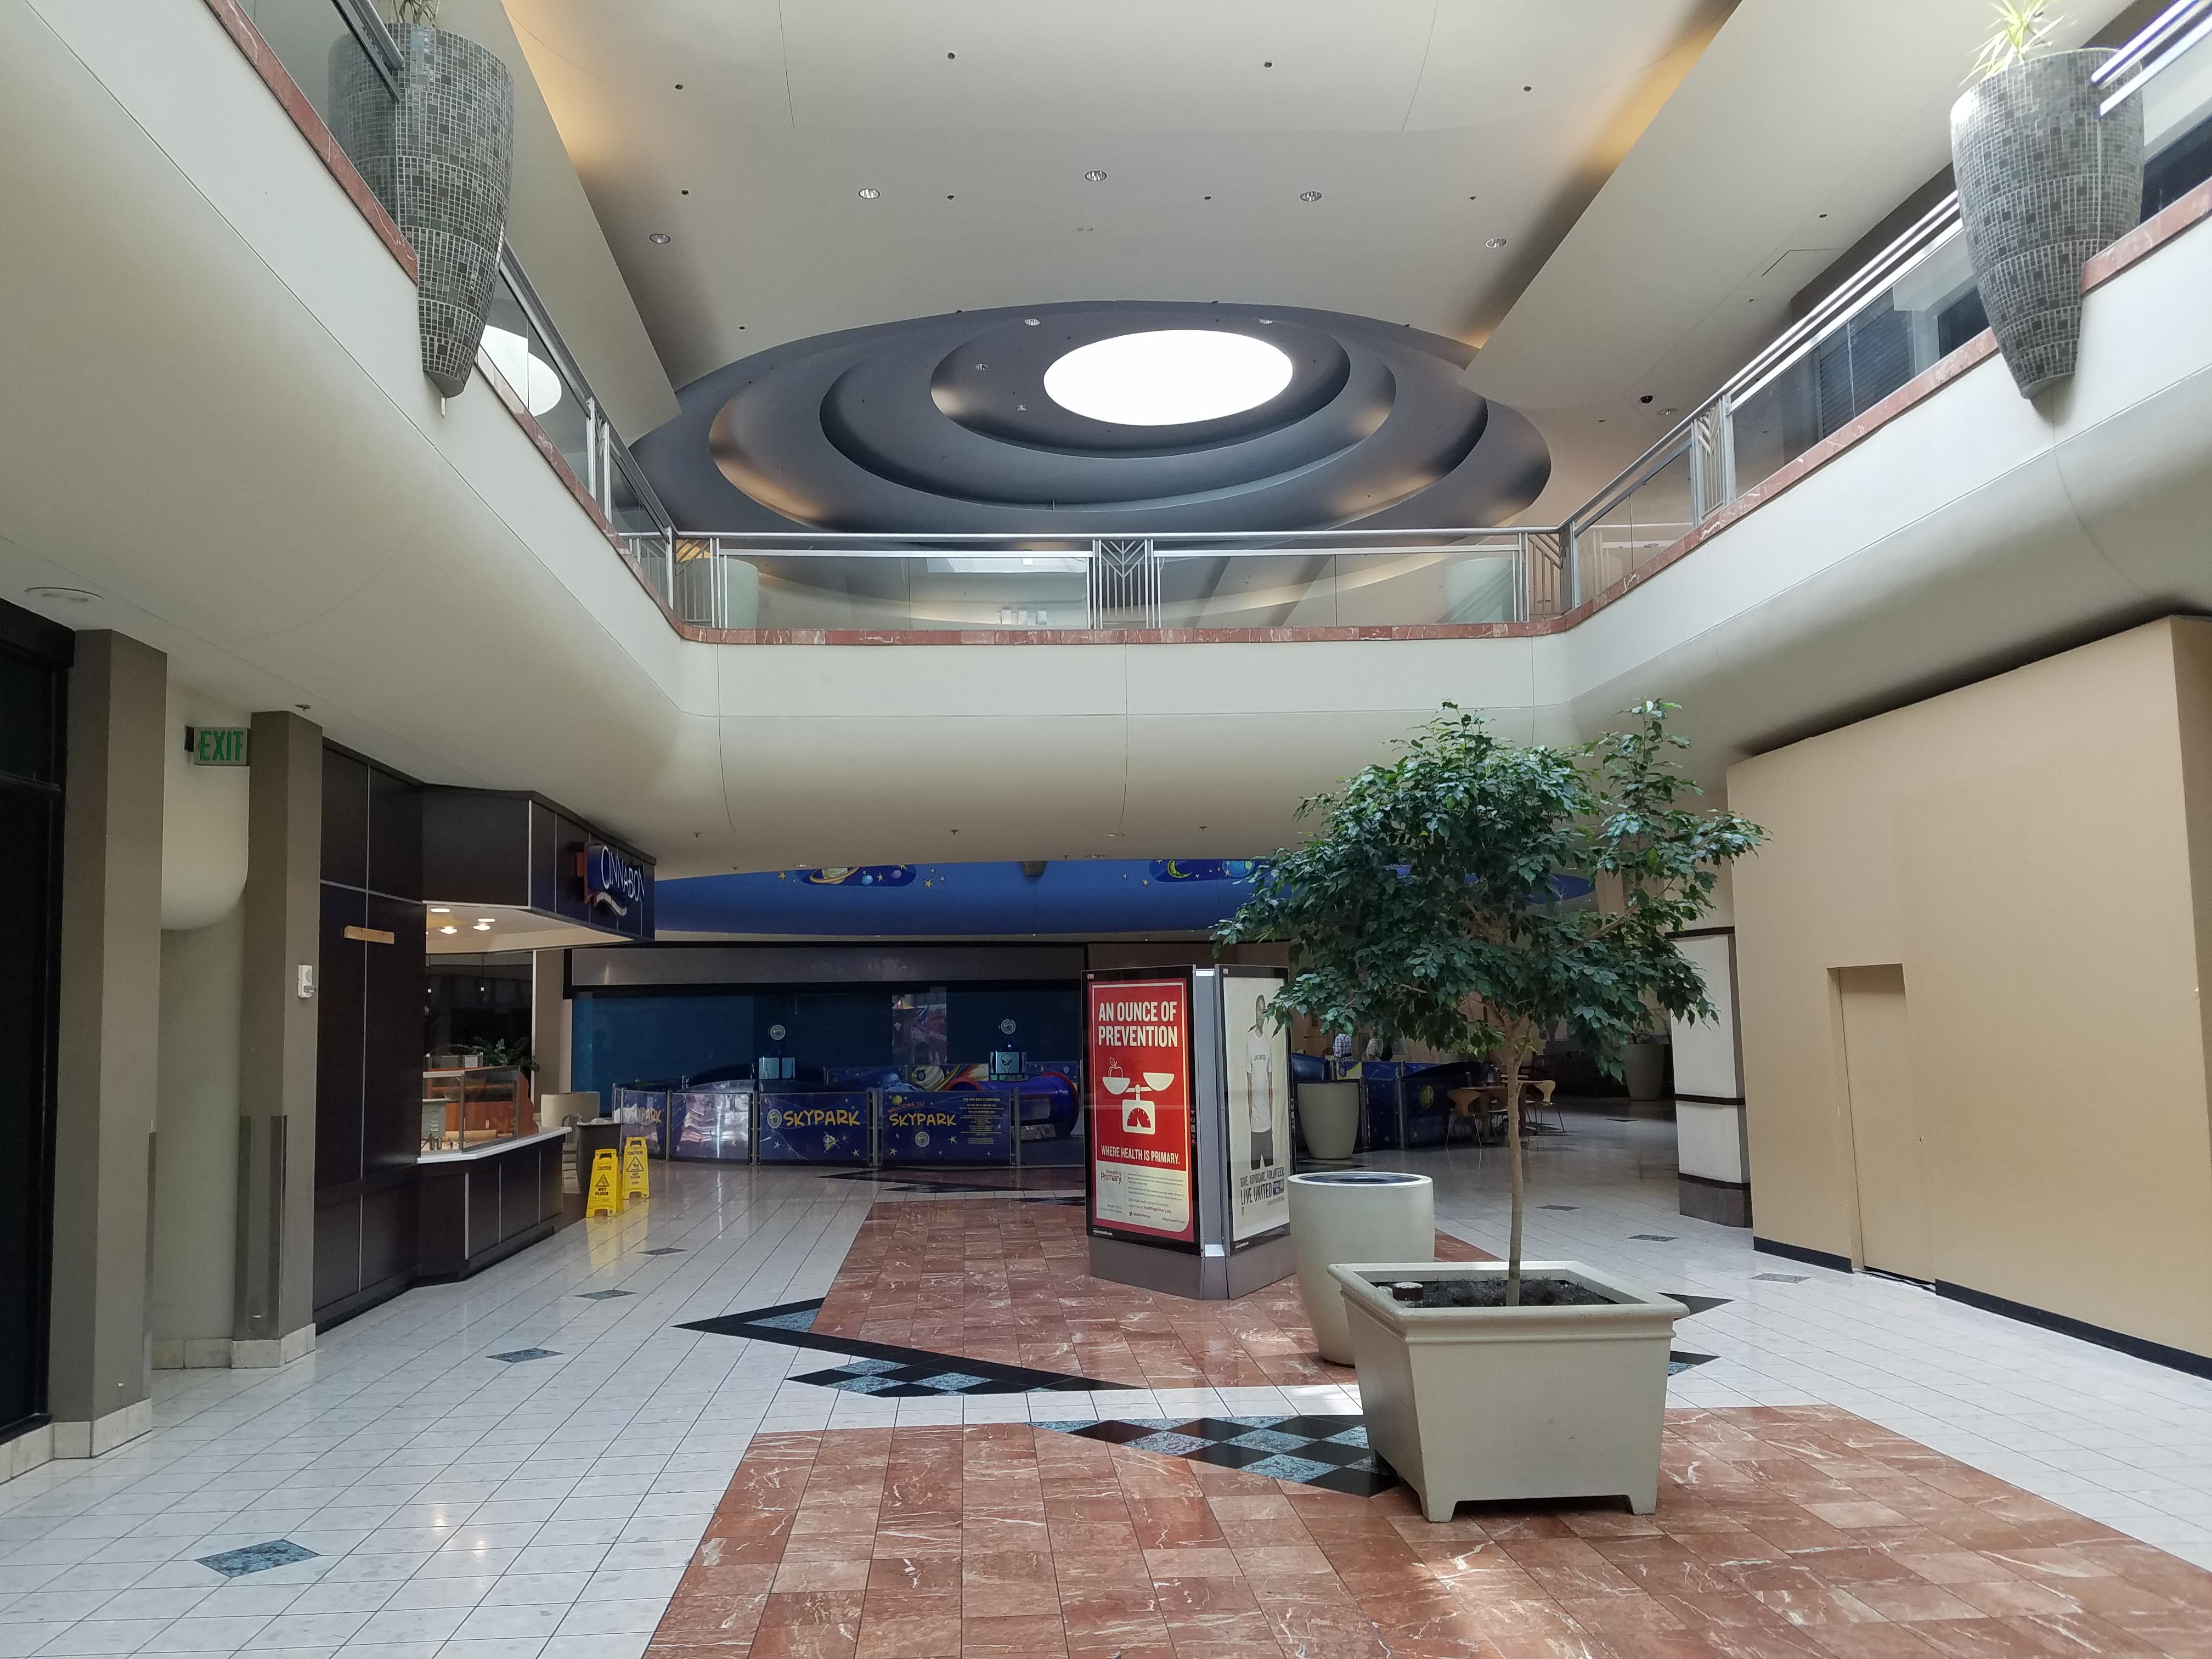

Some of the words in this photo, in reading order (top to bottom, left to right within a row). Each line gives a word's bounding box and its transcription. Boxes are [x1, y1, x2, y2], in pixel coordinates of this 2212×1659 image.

[199, 730, 244, 761] EXIT
[601, 845, 645, 902] CINNABON
[1098, 1002, 1114, 1022] AN
[1117, 1001, 1158, 1022] OUNCE
[1161, 1001, 1177, 1022] OF
[1098, 1025, 1178, 1047] PREVENTION
[783, 1109, 860, 1127] SKYPARK
[889, 1113, 957, 1127] SKYPARK
[1101, 1144, 1120, 1158] WHERE
[1121, 1147, 1143, 1160] HEALTH
[1144, 1149, 1150, 1161] IS
[1151, 1150, 1181, 1165] PRIMARY.
[1101, 1172, 1122, 1184] Primary
[1240, 1187, 1253, 1205] LIVE
[1253, 1182, 1272, 1202] UNITED
